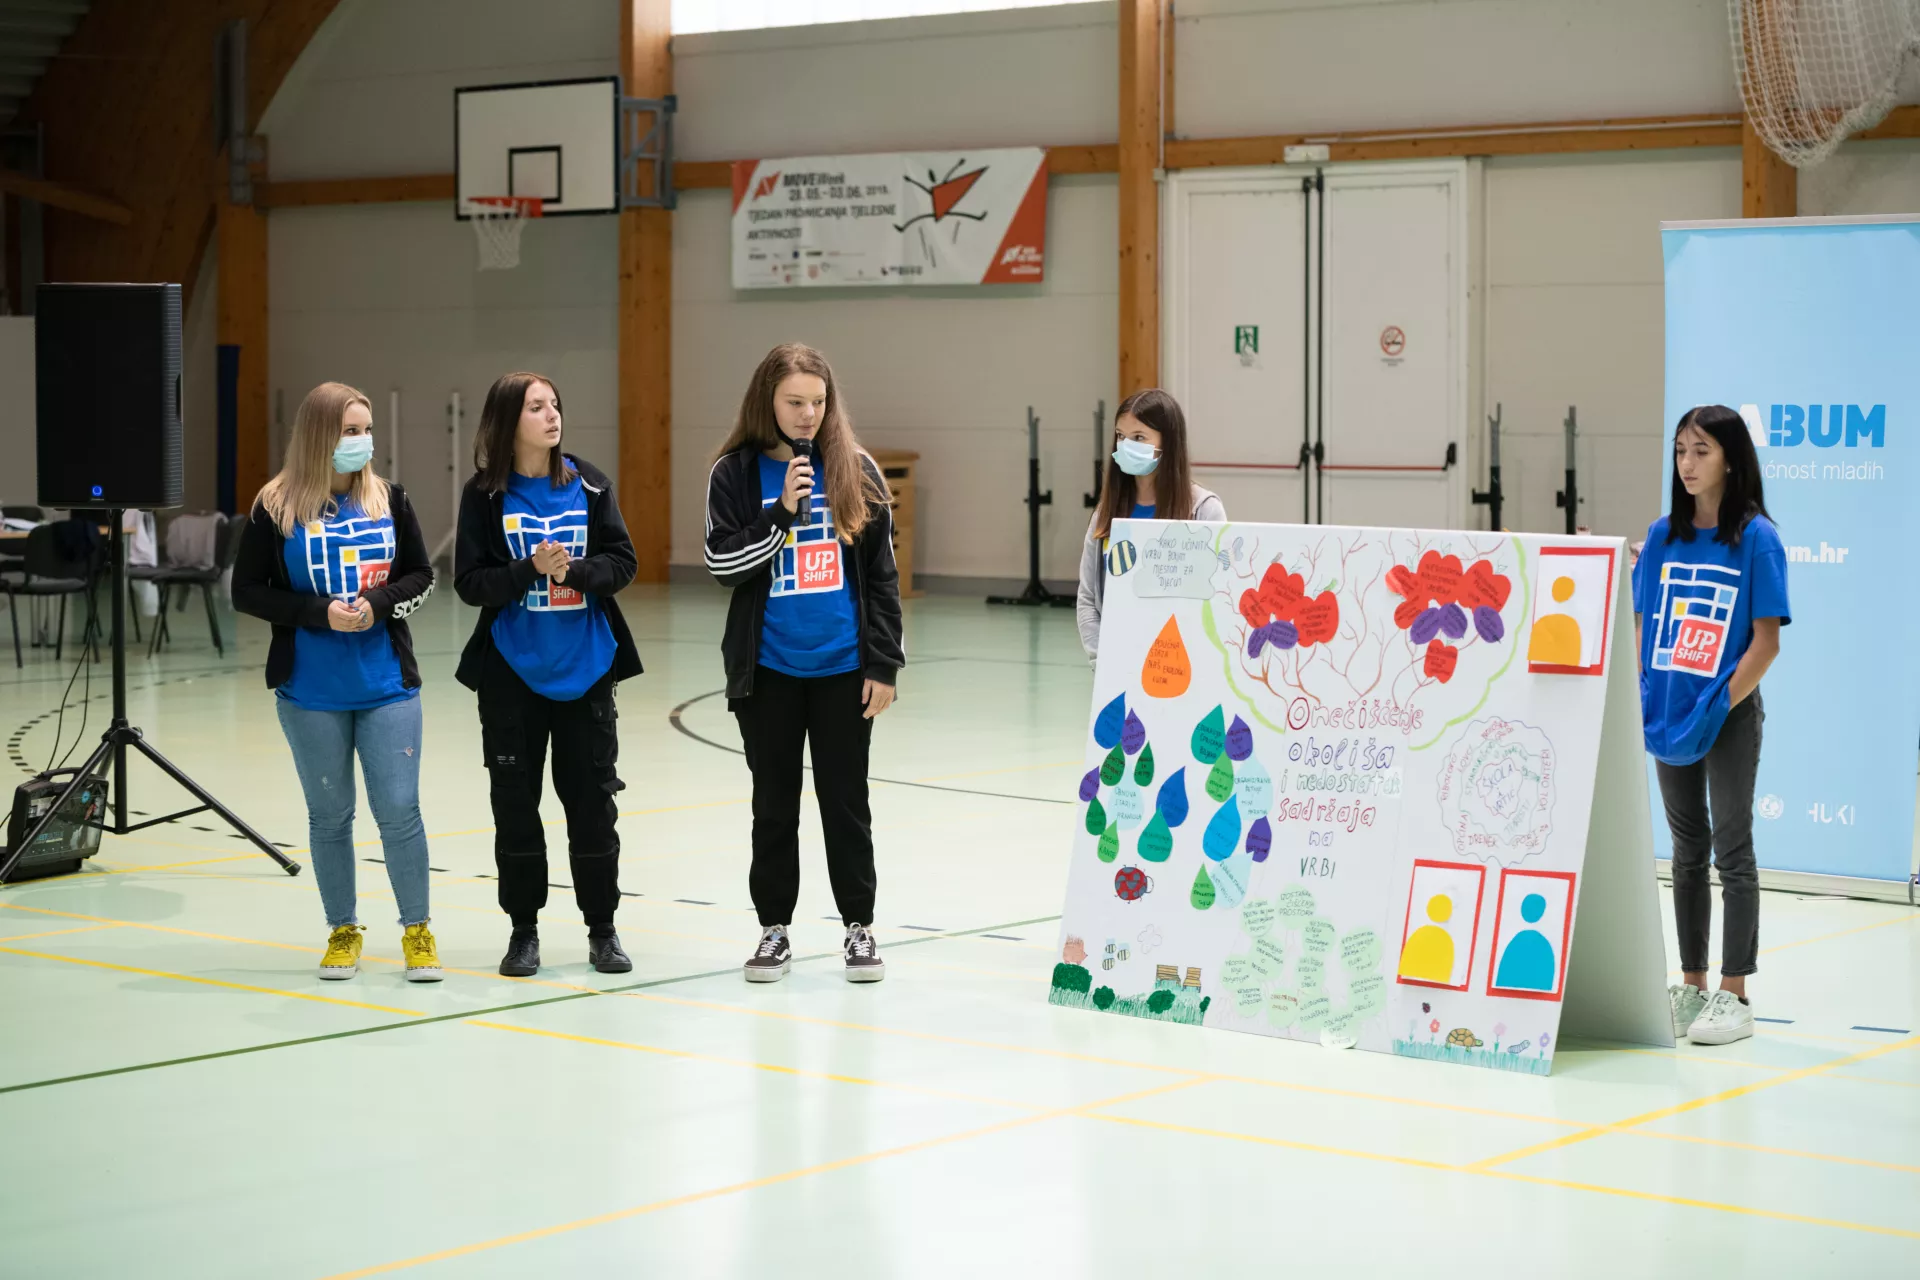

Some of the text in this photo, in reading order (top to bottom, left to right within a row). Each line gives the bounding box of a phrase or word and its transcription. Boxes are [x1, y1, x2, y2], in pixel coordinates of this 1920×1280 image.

[1696, 403, 1886, 448] ABUM
[1761, 459, 1885, 480] ćnost mladih
[1145, 549, 1162, 559] VRBU
[1160, 538, 1177, 549] KAKO
[805, 550, 835, 571] UP
[1153, 564, 1194, 577] MJESTOM ZA
[367, 569, 389, 589] UP
[803, 569, 835, 582] SHIFT
[1682, 627, 1717, 651] UP
[1676, 647, 1711, 664] SHIFT
[1288, 697, 1424, 735] Onečišćenje
[1289, 736, 1395, 770] okoliša
[1280, 767, 1401, 796] i nedostatak
[1308, 831, 1334, 847] na
[1300, 856, 1336, 879] VRBI
